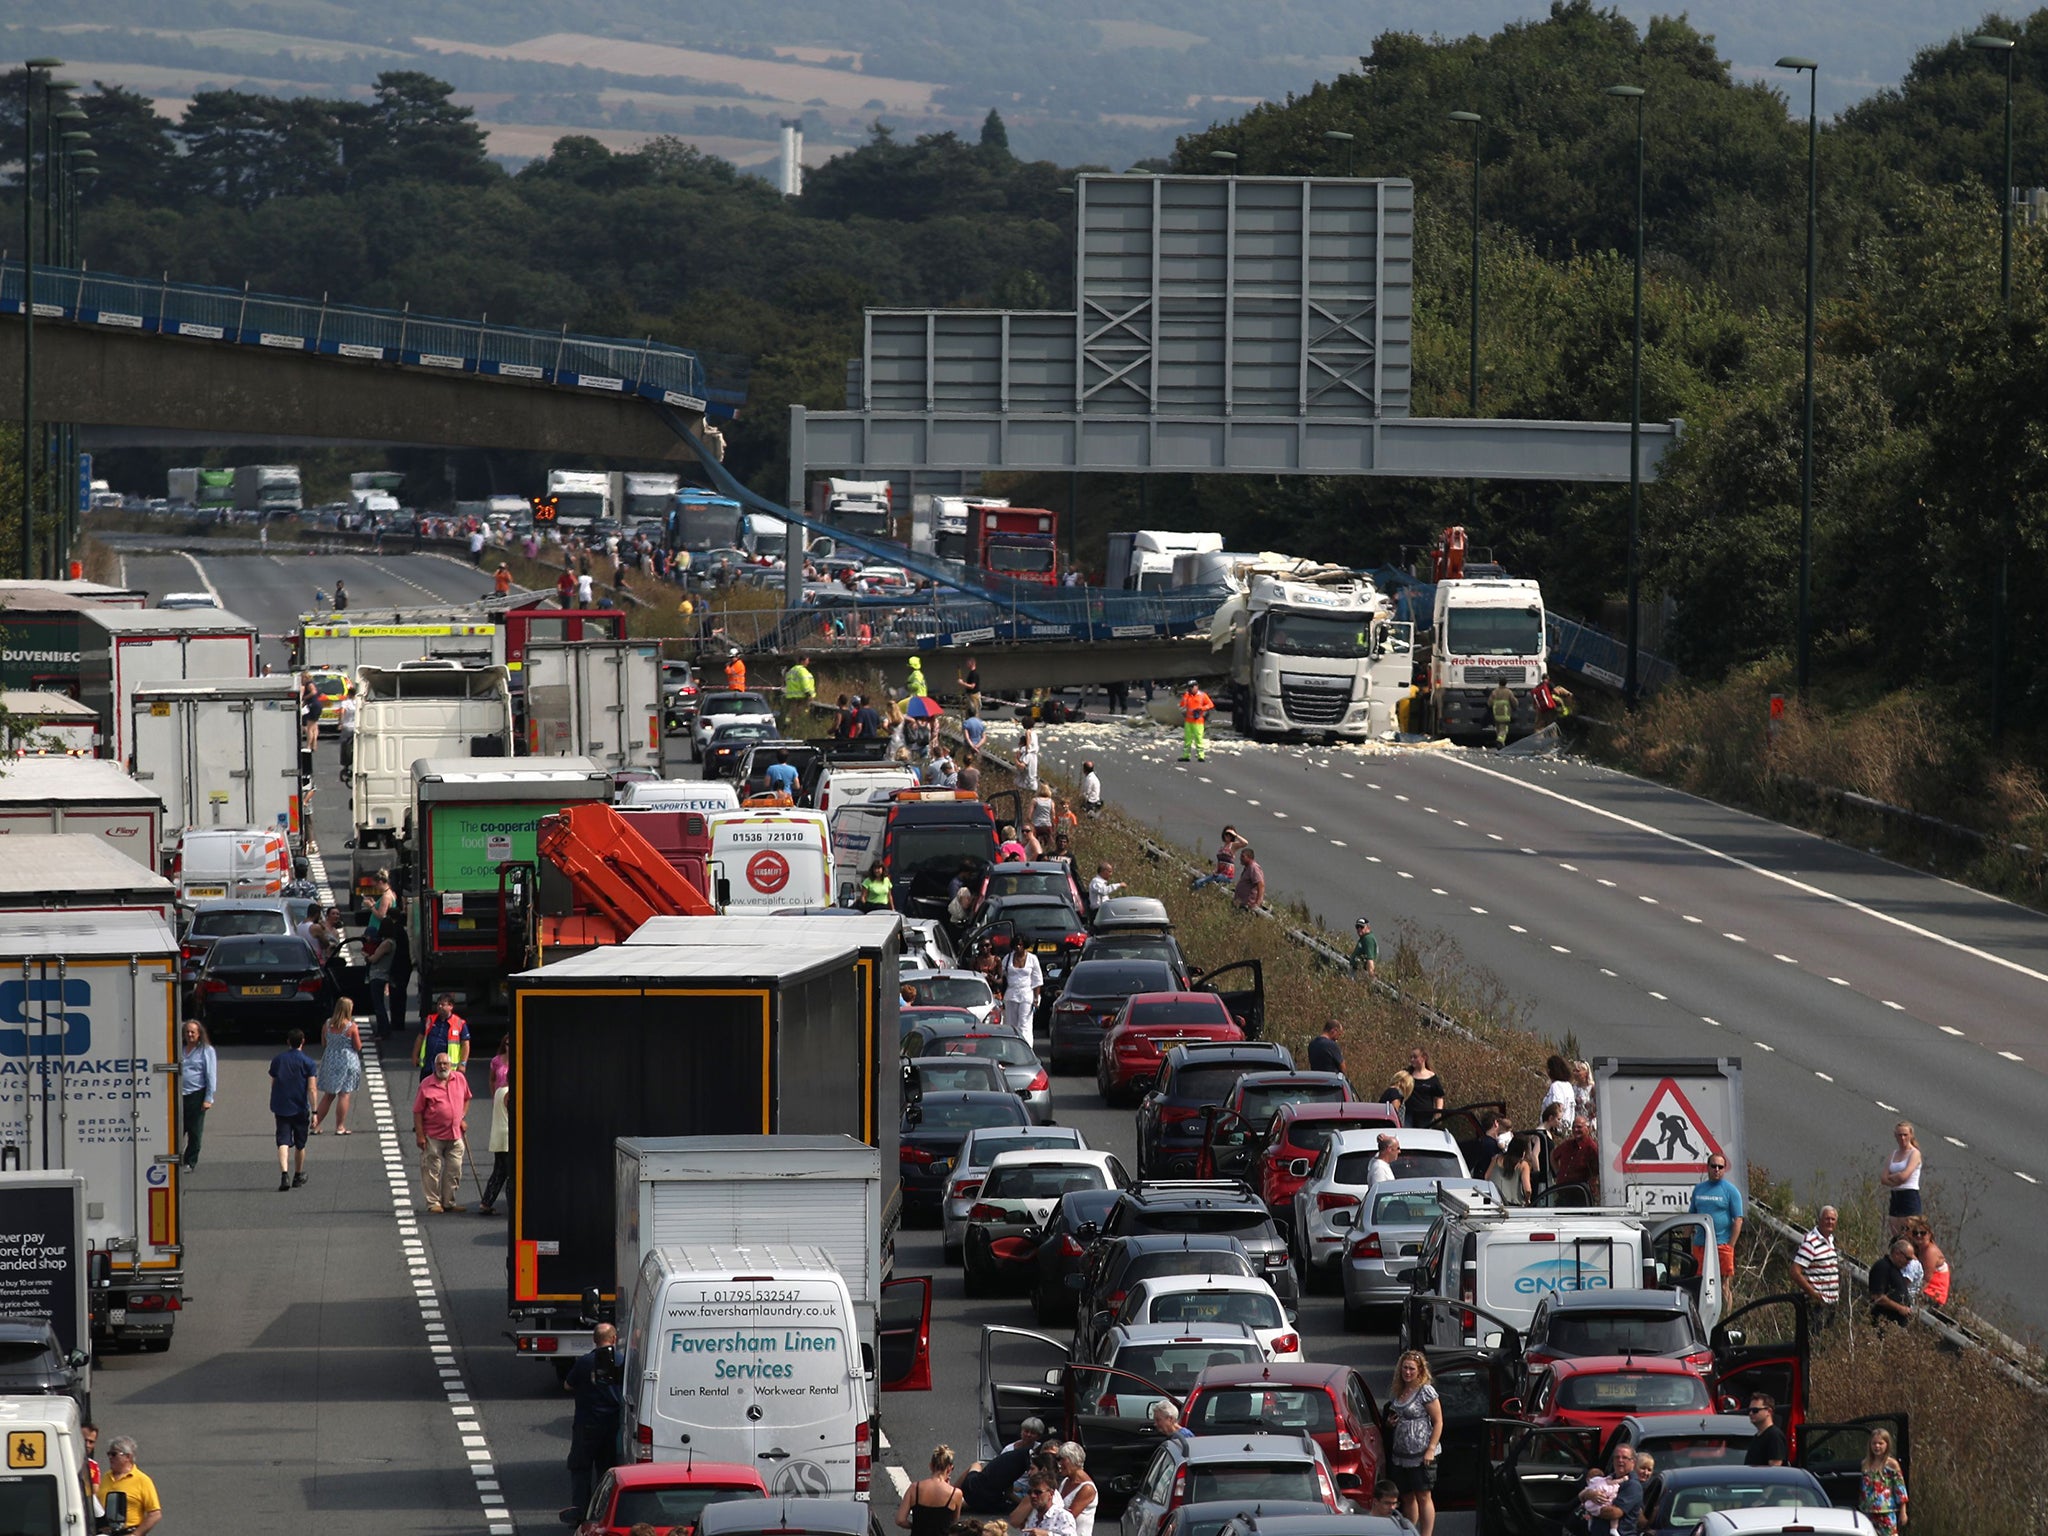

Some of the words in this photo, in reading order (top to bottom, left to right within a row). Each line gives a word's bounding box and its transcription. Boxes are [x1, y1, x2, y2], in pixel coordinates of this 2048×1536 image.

[535, 505, 556, 520] 20
[1478, 657, 1539, 666] Renovations
[690, 800, 726, 810] EVEN
[459, 820, 478, 832] The
[461, 836, 484, 848] food
[732, 833, 762, 842] 01536
[767, 832, 803, 841] 721010
[754, 867, 783, 876] VERSALIFT
[1, 1059, 148, 1075] AVEMAKER
[65, 1077, 150, 1088] Transport
[1645, 1191, 1655, 1205] 2
[1662, 1192, 1691, 1205] mil
[23, 1233, 45, 1245] pay
[21, 1244, 38, 1256] for
[40, 1246, 66, 1258] your
[0, 1258, 36, 1270] anded
[39, 1258, 67, 1271] shop
[714, 1291, 751, 1301] 01795
[756, 1290, 800, 1301] 532547
[5, 1301, 20, 1309] price
[668, 1305, 836, 1318] www.favershamlaundry.co.uk
[671, 1331, 776, 1352] Faversham
[784, 1331, 837, 1351] Linen
[714, 1358, 793, 1379] Services
[669, 1387, 695, 1396] Linen
[700, 1386, 729, 1396] Rental
[754, 1386, 806, 1396] Workwear
[809, 1385, 839, 1395] Rental
